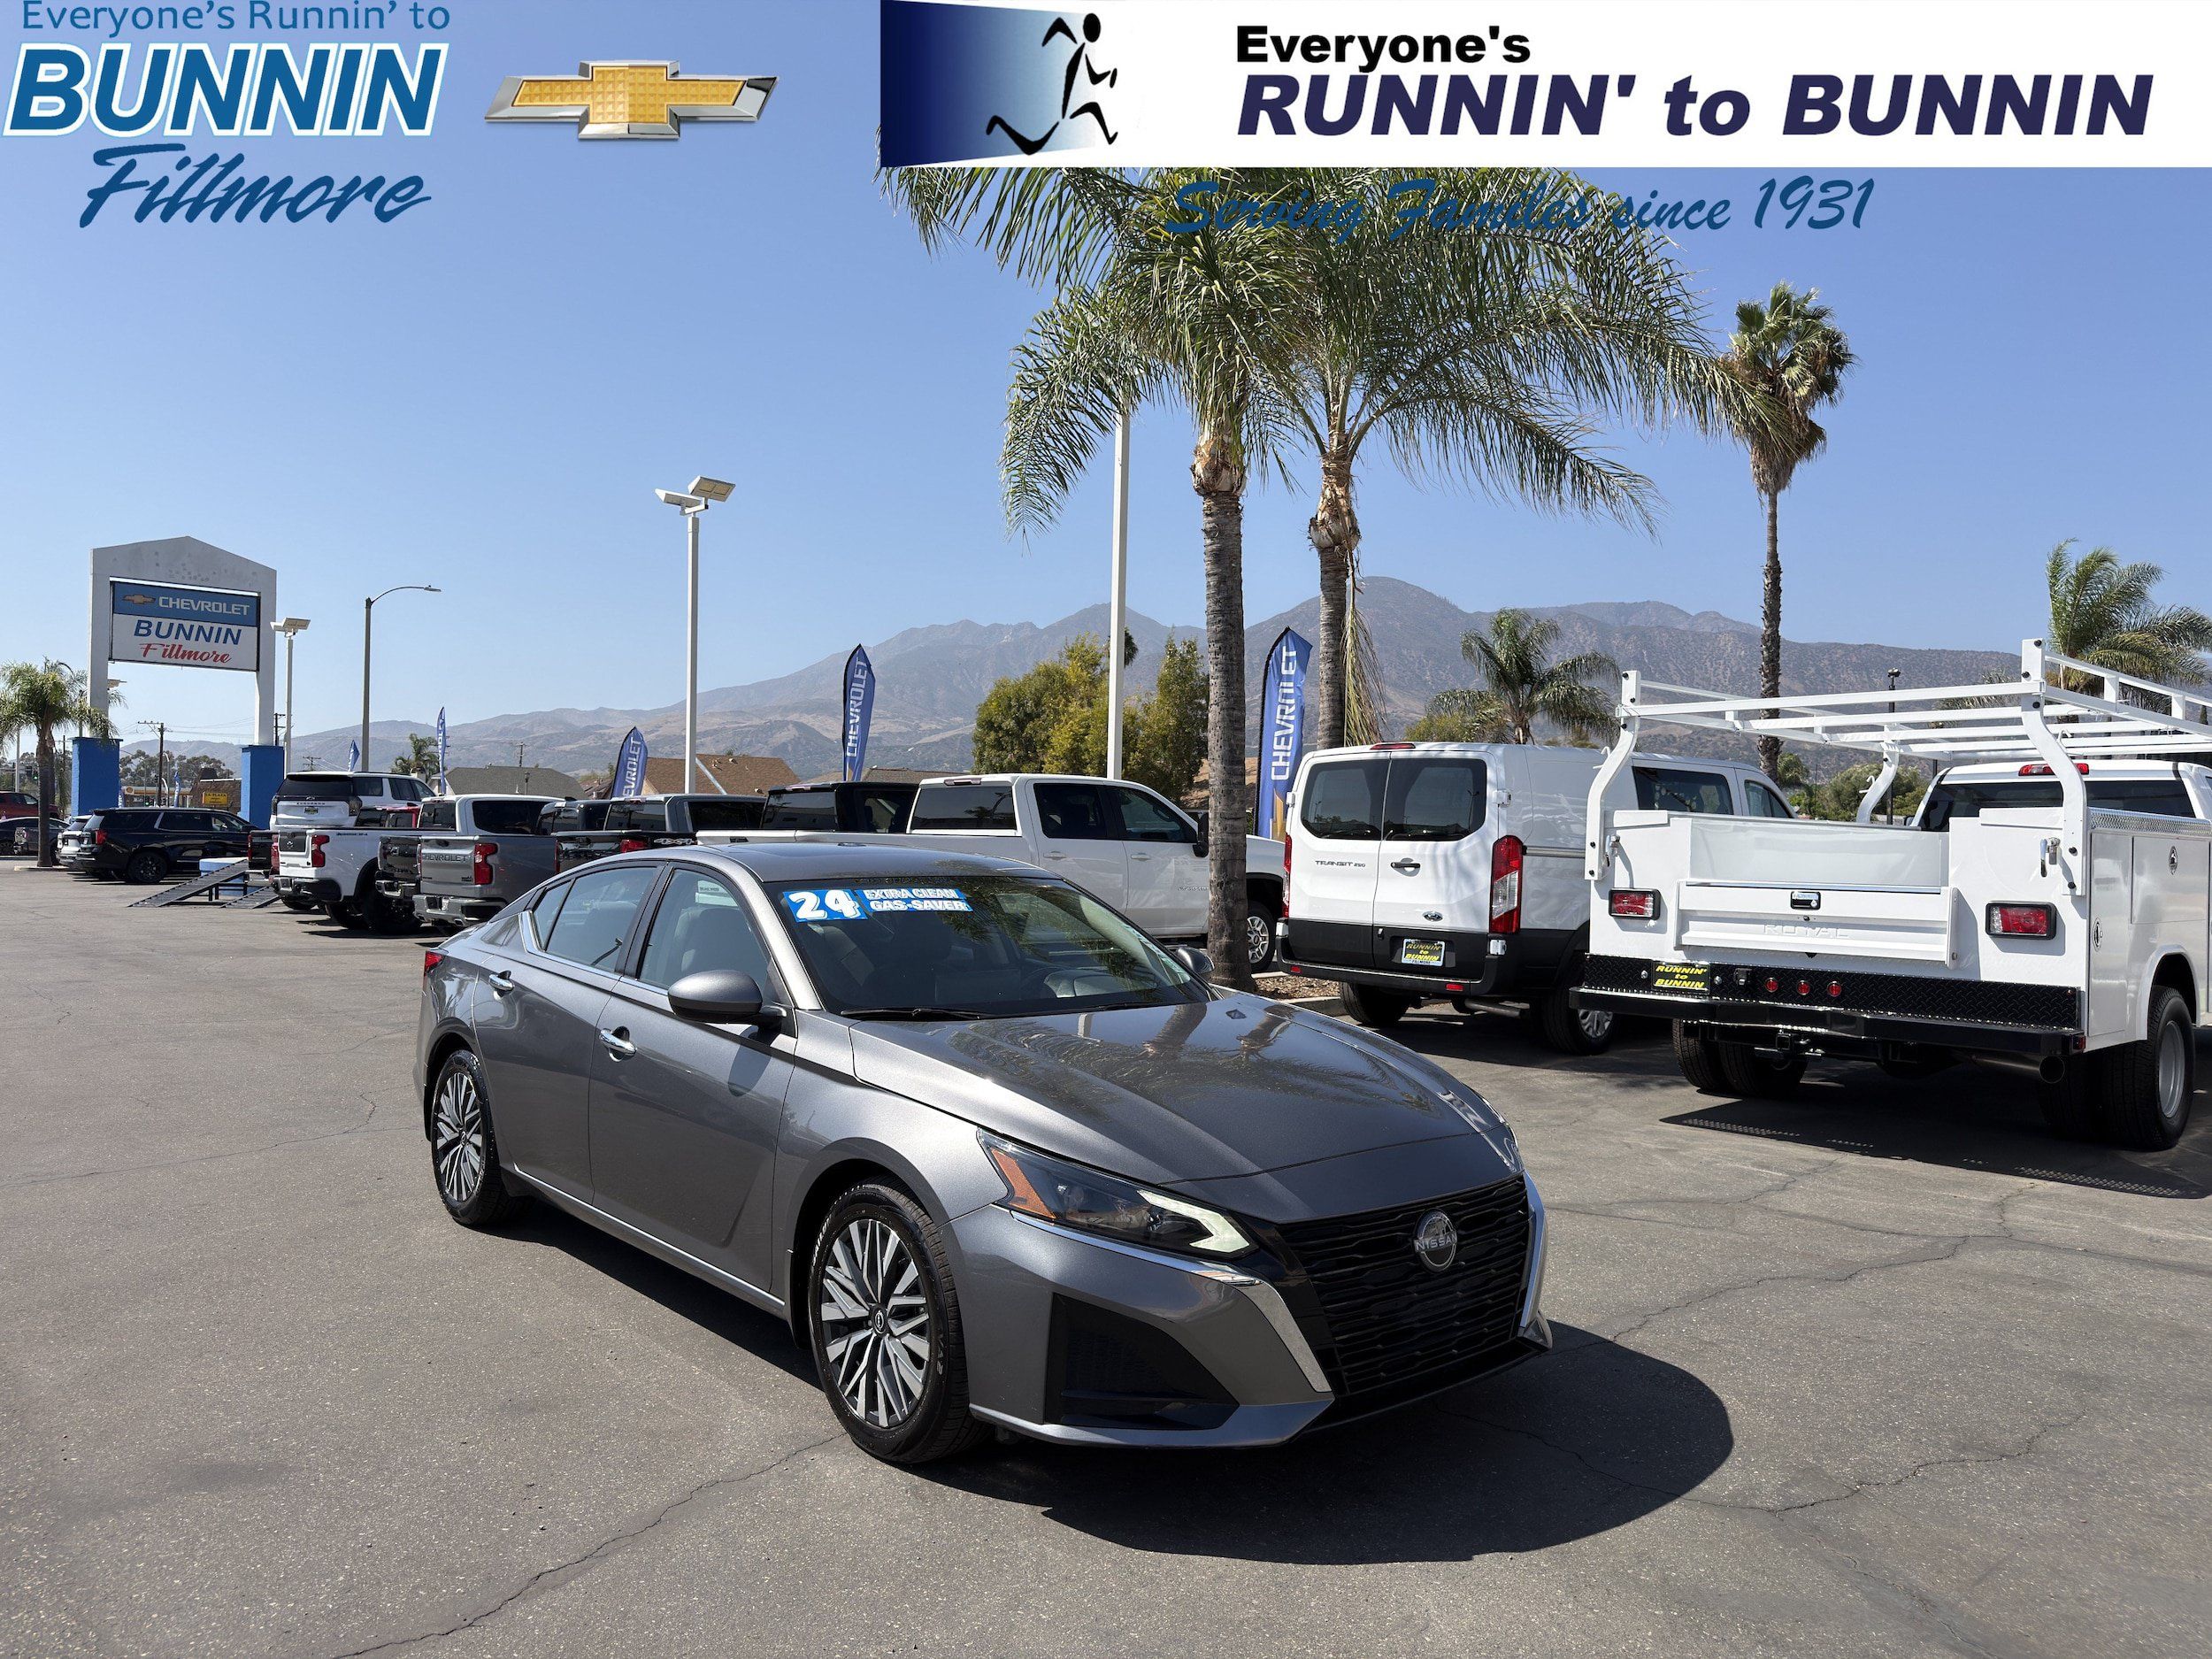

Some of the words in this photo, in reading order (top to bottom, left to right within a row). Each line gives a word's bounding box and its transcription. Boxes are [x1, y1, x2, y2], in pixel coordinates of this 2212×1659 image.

[158, 596, 250, 616] CHEVROLET
[134, 619, 242, 645] BUNNIN
[139, 642, 232, 664] Fillmore
[846, 657, 868, 757] CHEVROLET
[863, 888, 915, 900] EXTRA
[911, 888, 959, 899] CLEAN
[788, 890, 862, 919] 24
[1764, 924, 1850, 939] ROYAL
[1655, 964, 1708, 976] RUNNIN'
[1655, 978, 1705, 988] BUNNIN
[1416, 1233, 1457, 1251] NISSAN
